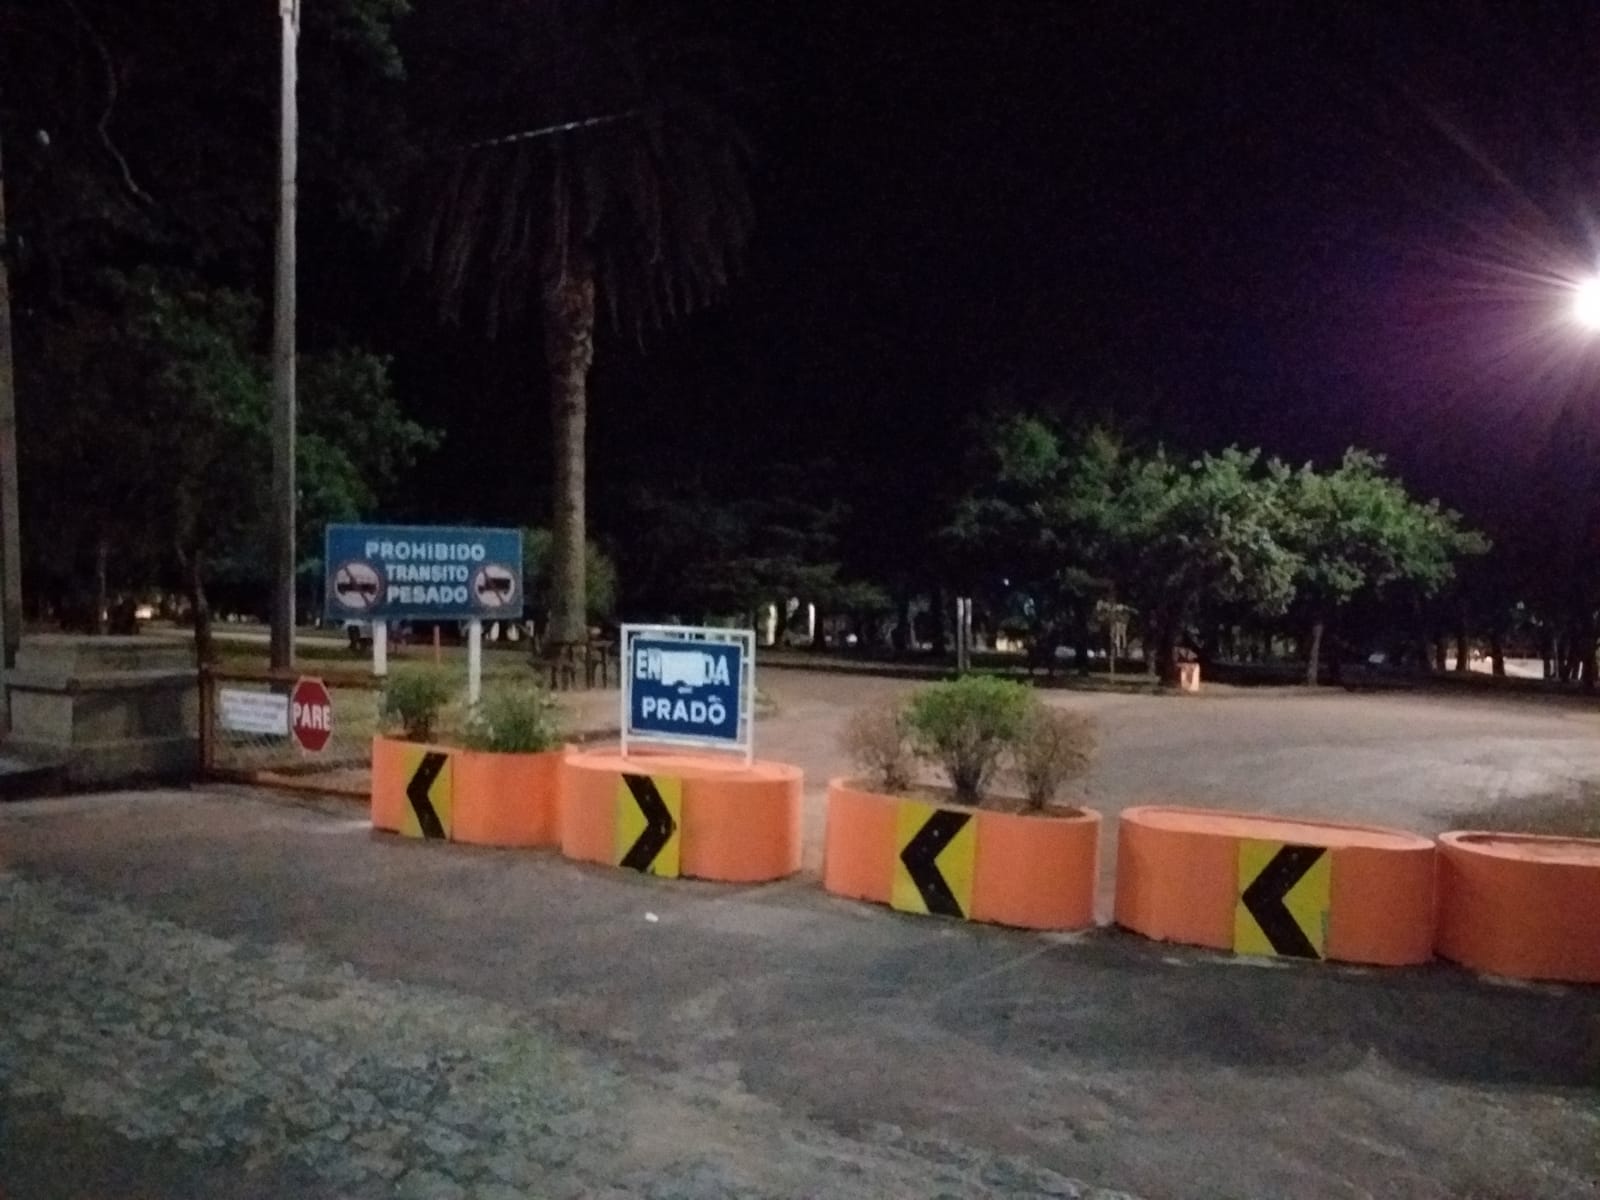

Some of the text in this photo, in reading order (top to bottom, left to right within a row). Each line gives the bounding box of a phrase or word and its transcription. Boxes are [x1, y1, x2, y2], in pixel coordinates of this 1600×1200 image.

[365, 541, 486, 561] PROHIBIDO
[386, 564, 469, 582] TRANSITO
[387, 585, 469, 603] PESADO
[636, 648, 730, 686] ENDA
[293, 701, 331, 731] PARE
